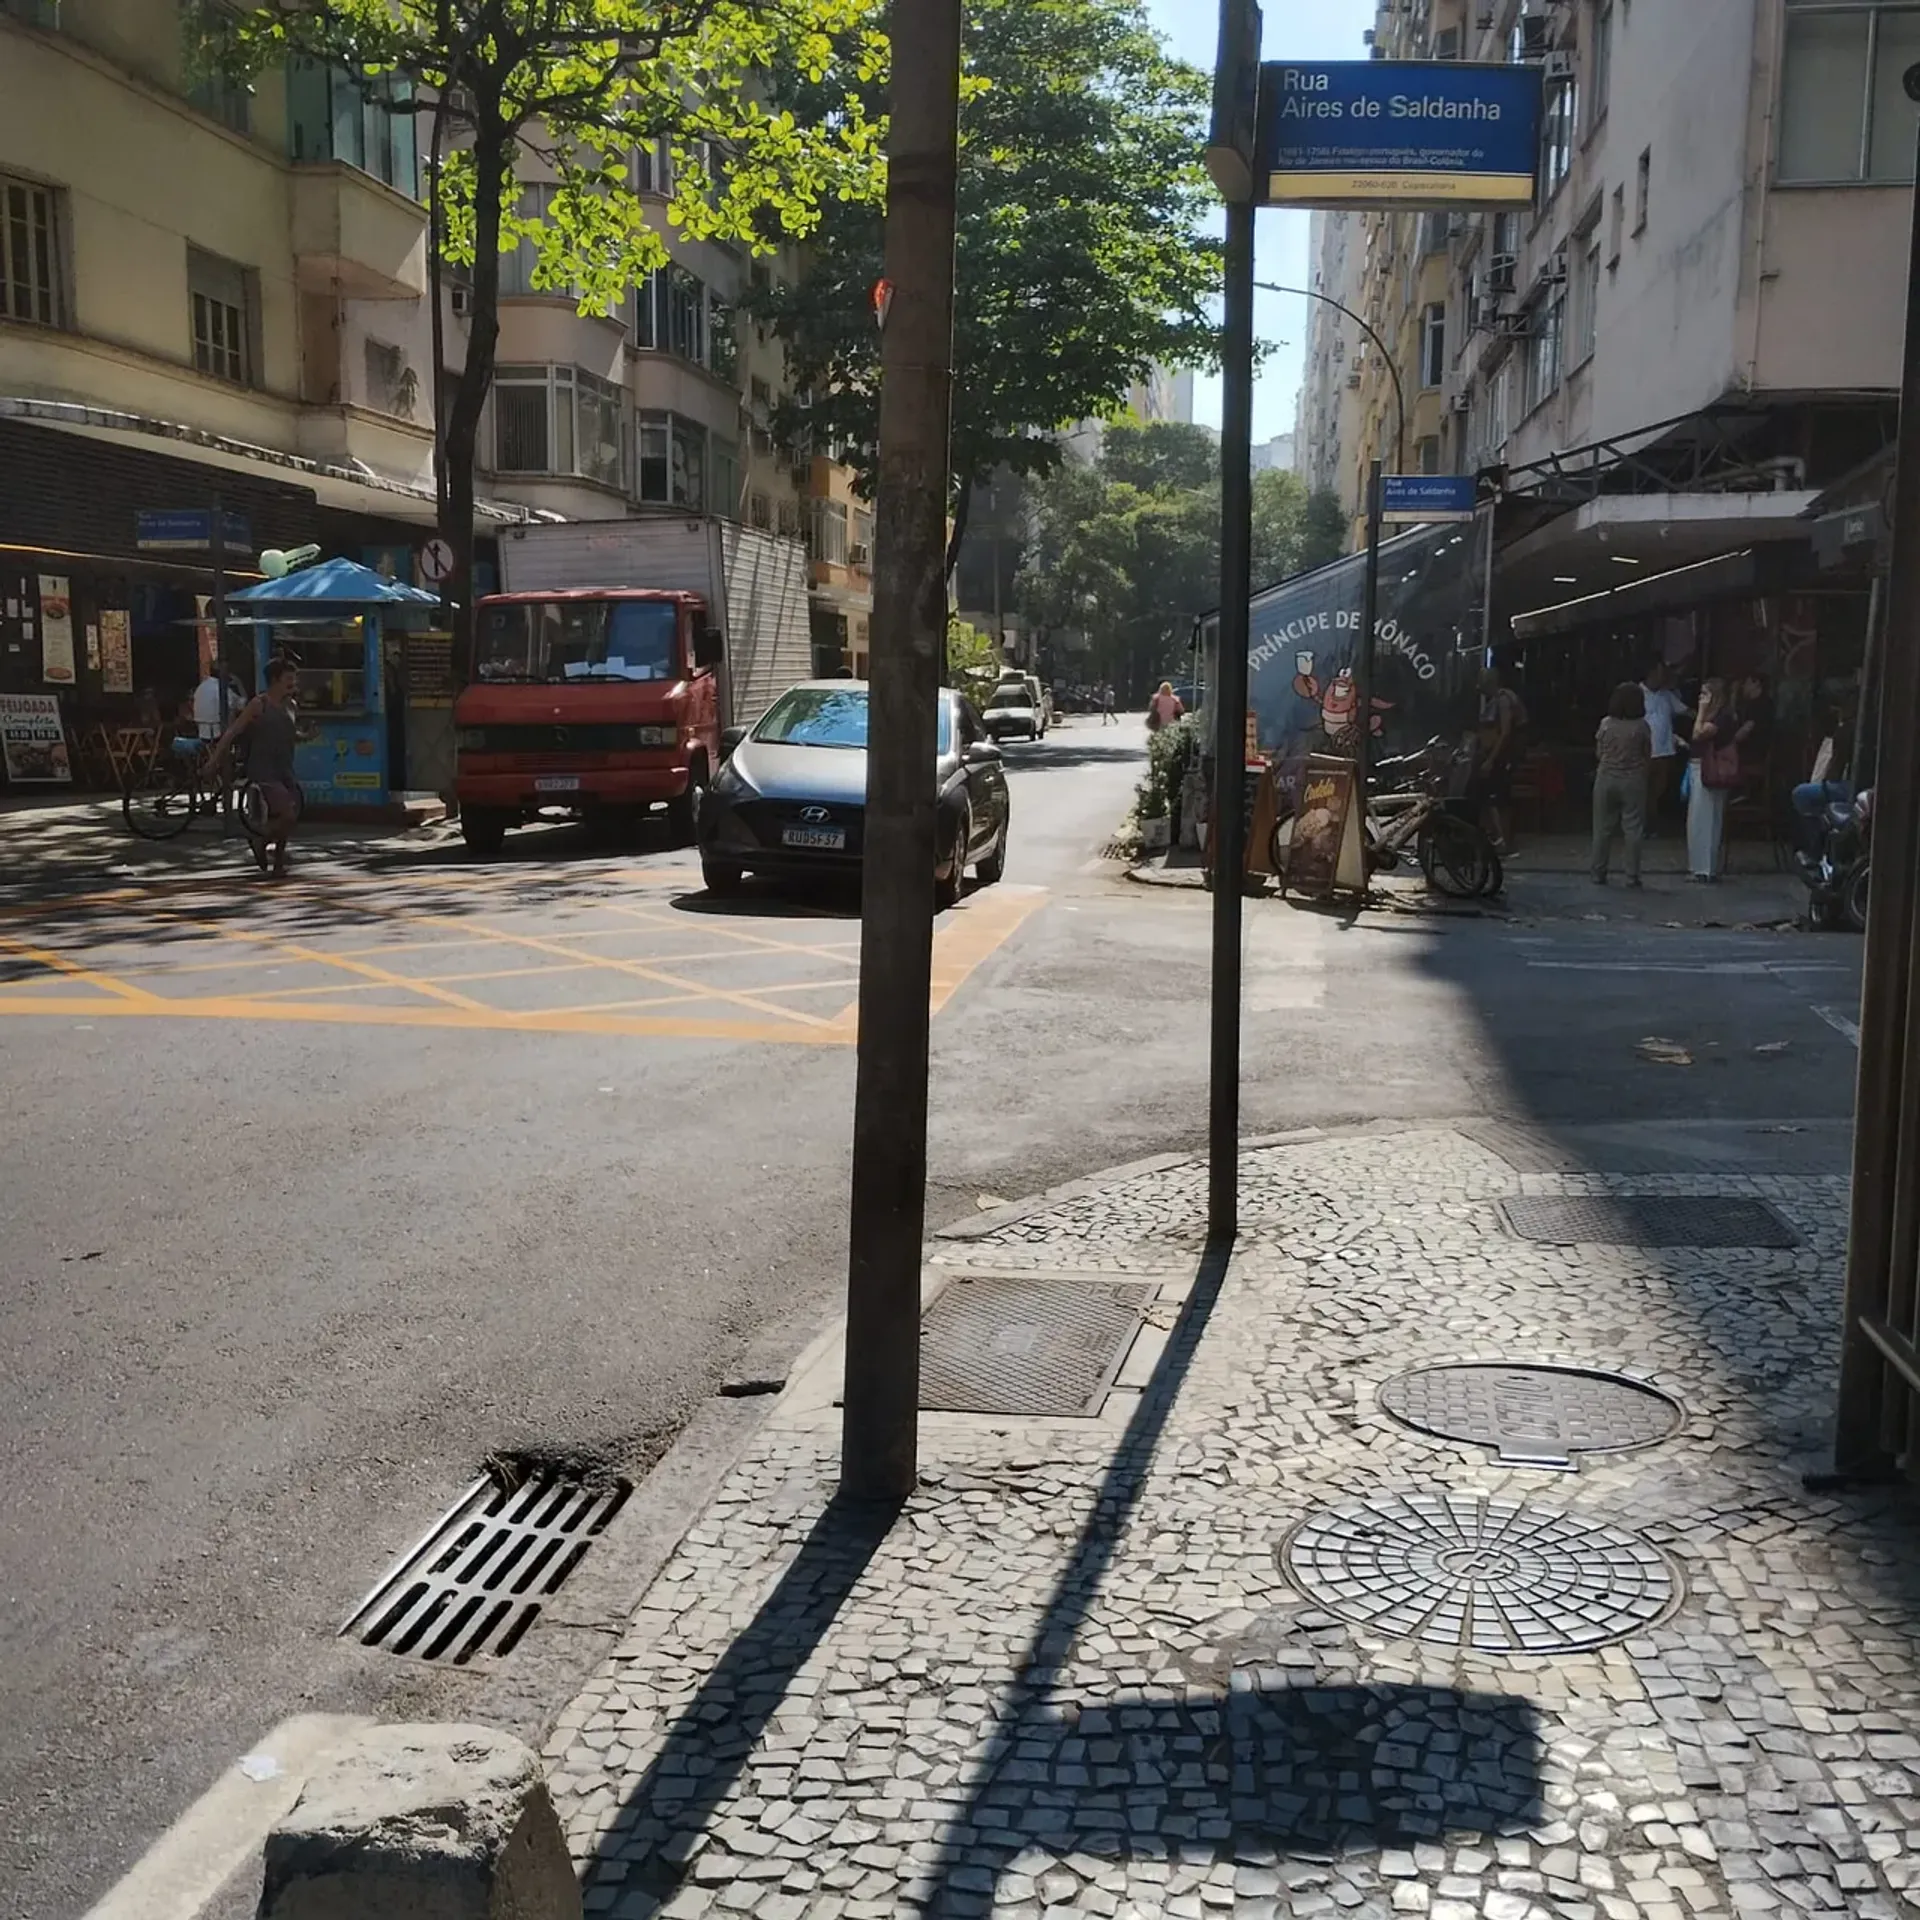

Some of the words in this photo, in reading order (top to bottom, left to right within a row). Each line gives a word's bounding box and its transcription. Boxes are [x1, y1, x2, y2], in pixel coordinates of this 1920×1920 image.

[1283, 69, 1329, 91] Rua
[1280, 95, 1344, 119] Aires
[1350, 96, 1381, 118] de
[1388, 94, 1502, 121] Saldanha
[1247, 612, 1331, 672] PRÍNCIPE
[1335, 610, 1362, 630] DE
